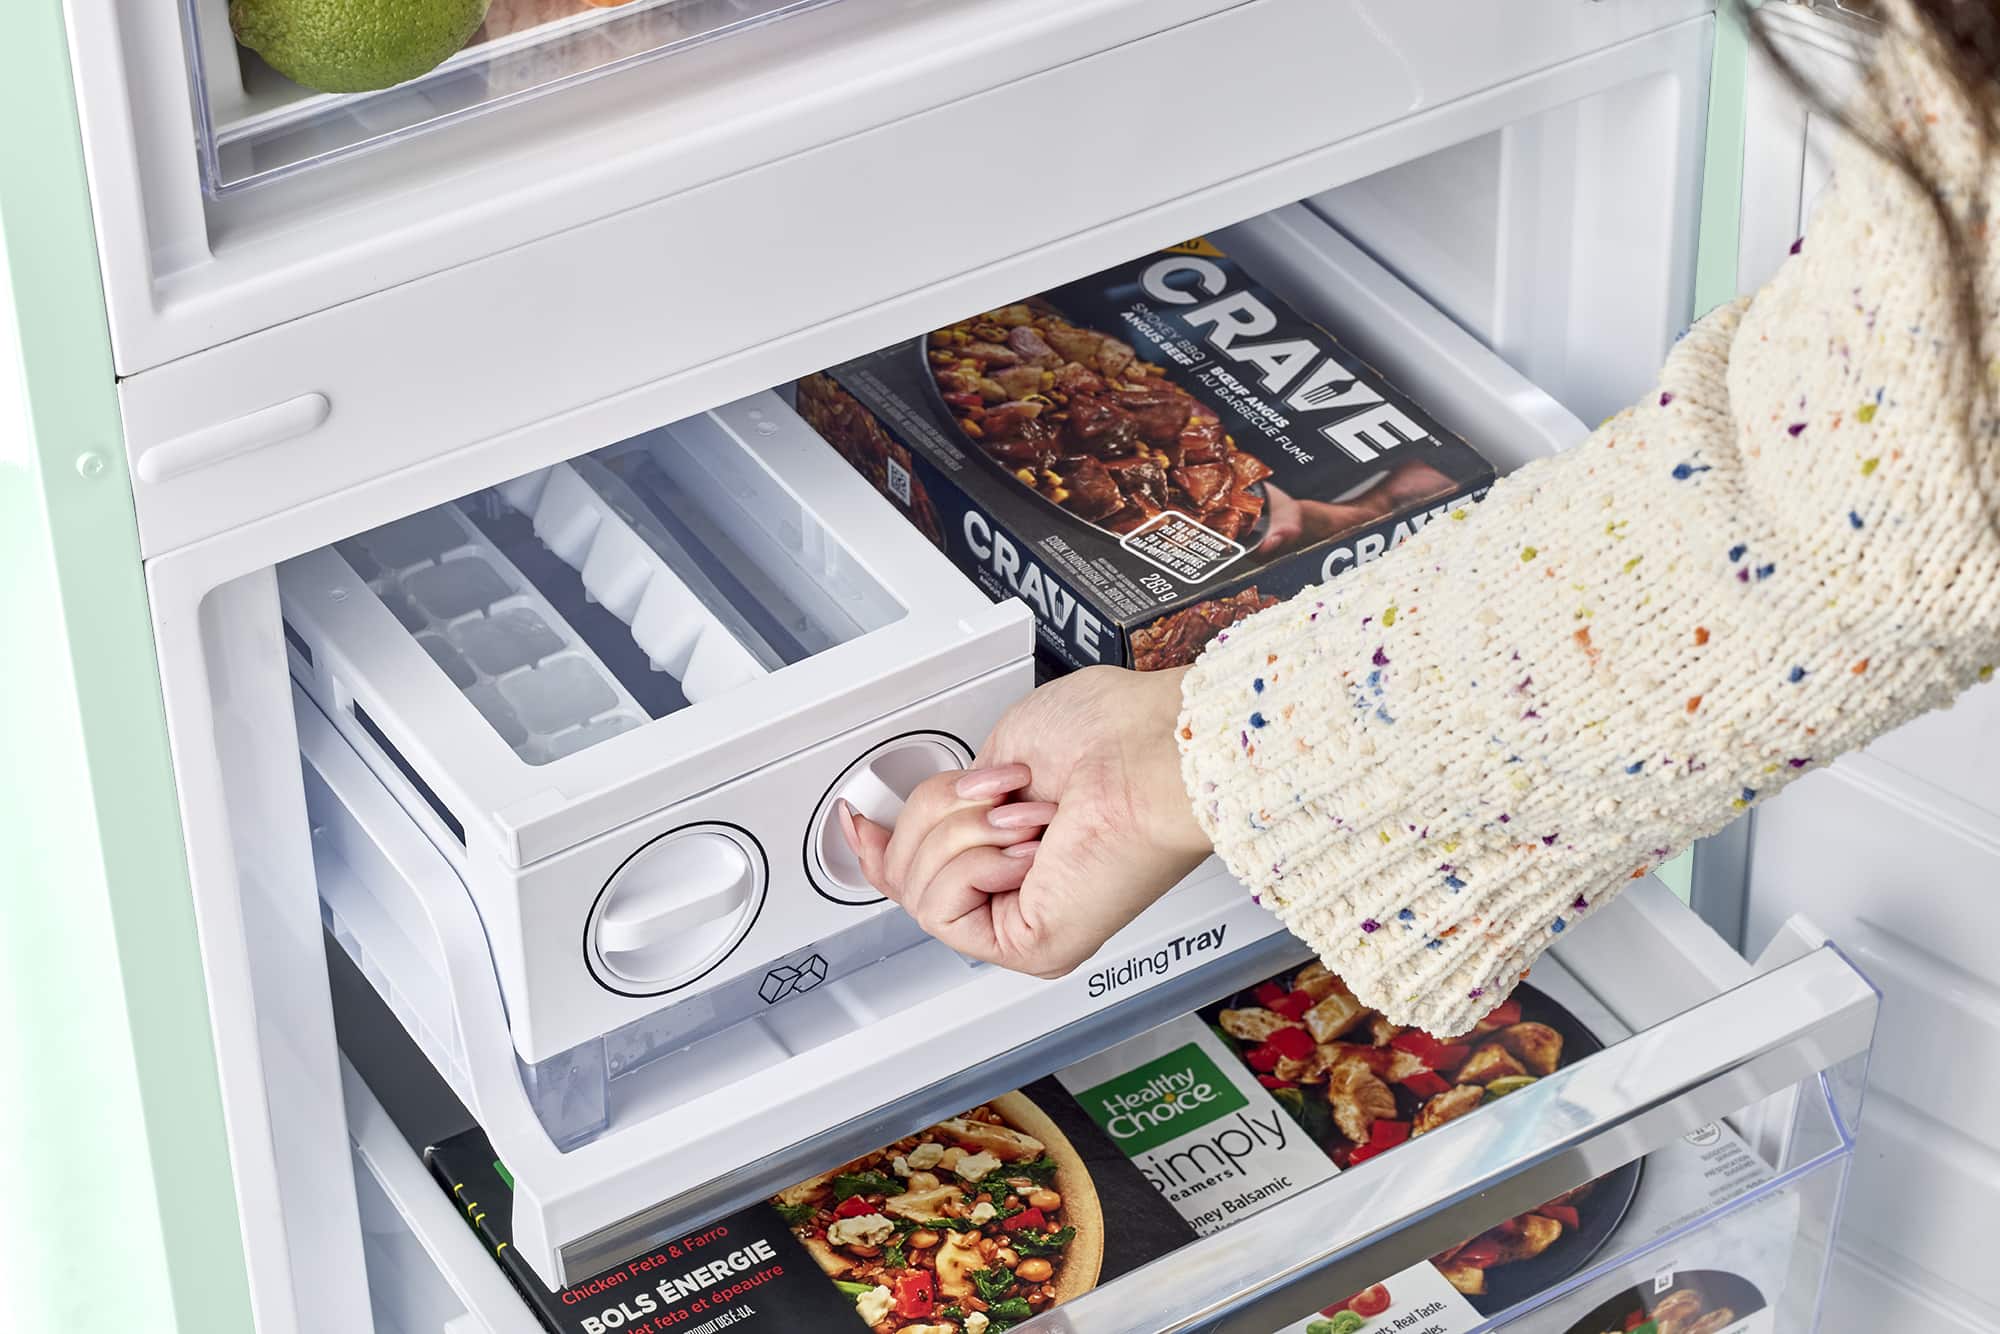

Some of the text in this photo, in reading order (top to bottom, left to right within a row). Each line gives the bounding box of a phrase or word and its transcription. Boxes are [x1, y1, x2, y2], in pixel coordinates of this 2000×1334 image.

[1120, 312, 1194, 365] ANGUS BEEF
[1131, 303, 1206, 360] SMOKEY BBQ
[1139, 257, 1429, 463] CRAVE
[1196, 373, 1314, 465] AU BARBECUE FUMÉ
[1210, 366, 1290, 428] BŒUF ANGUS
[963, 510, 1101, 662] CRAVE
[1046, 536, 1071, 554] COOK
[1062, 550, 1110, 586] THOROUGHLY
[1140, 573, 1178, 602] 283 g
[1087, 924, 1227, 998] SlidingTray
[1102, 1067, 1194, 1116] Healthy
[1107, 1083, 1217, 1138] Choice
[1169, 1169, 1234, 1202] eamers
[1188, 1208, 1224, 1230] oney
[1222, 1176, 1293, 1214] Balsamic
[562, 1225, 728, 1305] Chicken Feta & Farro
[580, 1293, 658, 1334] BOLS
[656, 1239, 777, 1304] ÉNERGIE
[654, 1308, 689, 1331] feta
[691, 1299, 711, 1314] et
[712, 1264, 784, 1304] épeautre
[714, 1313, 734, 1328] DES
[1392, 1312, 1420, 1330] Real
[1414, 1302, 1448, 1319] Taste.
